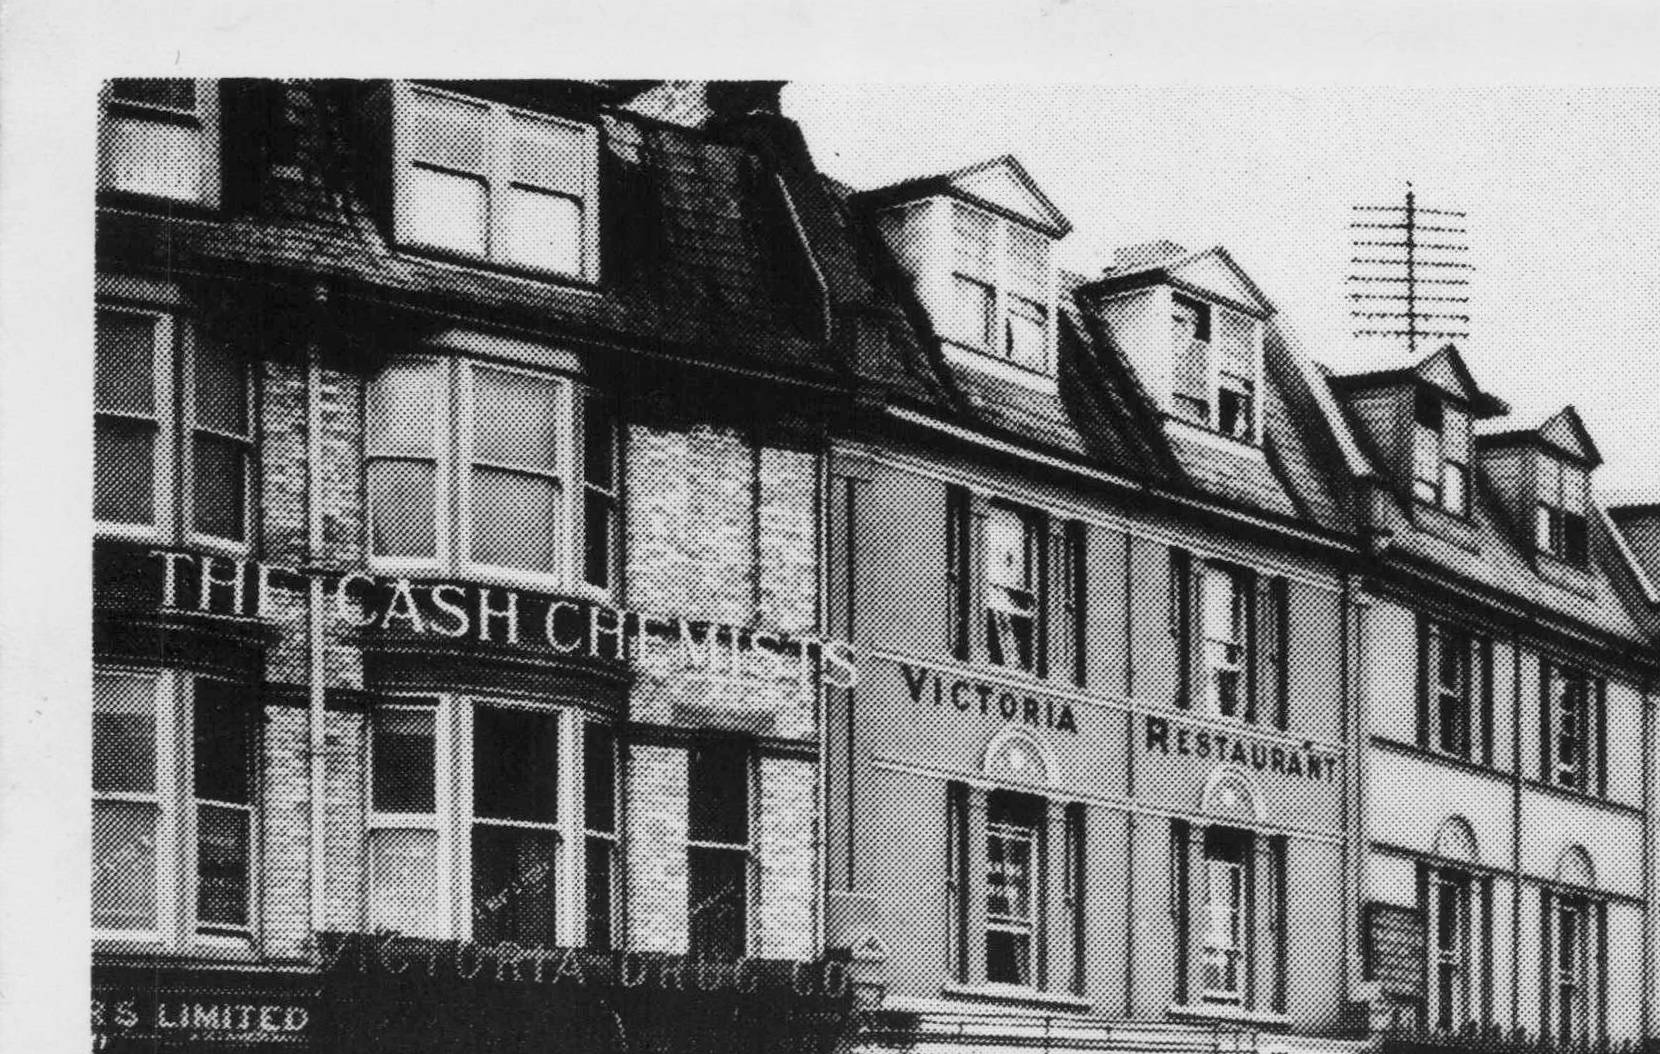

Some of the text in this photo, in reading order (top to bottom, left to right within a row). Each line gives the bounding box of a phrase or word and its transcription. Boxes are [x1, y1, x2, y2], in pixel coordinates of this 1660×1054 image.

[150, 550, 857, 690] THE CASH CHEMISTS
[901, 663, 1337, 781] VICTORIA RESTAURANT
[319, 928, 587, 985] VICTORIA
[158, 1002, 309, 1033] LIMITED
